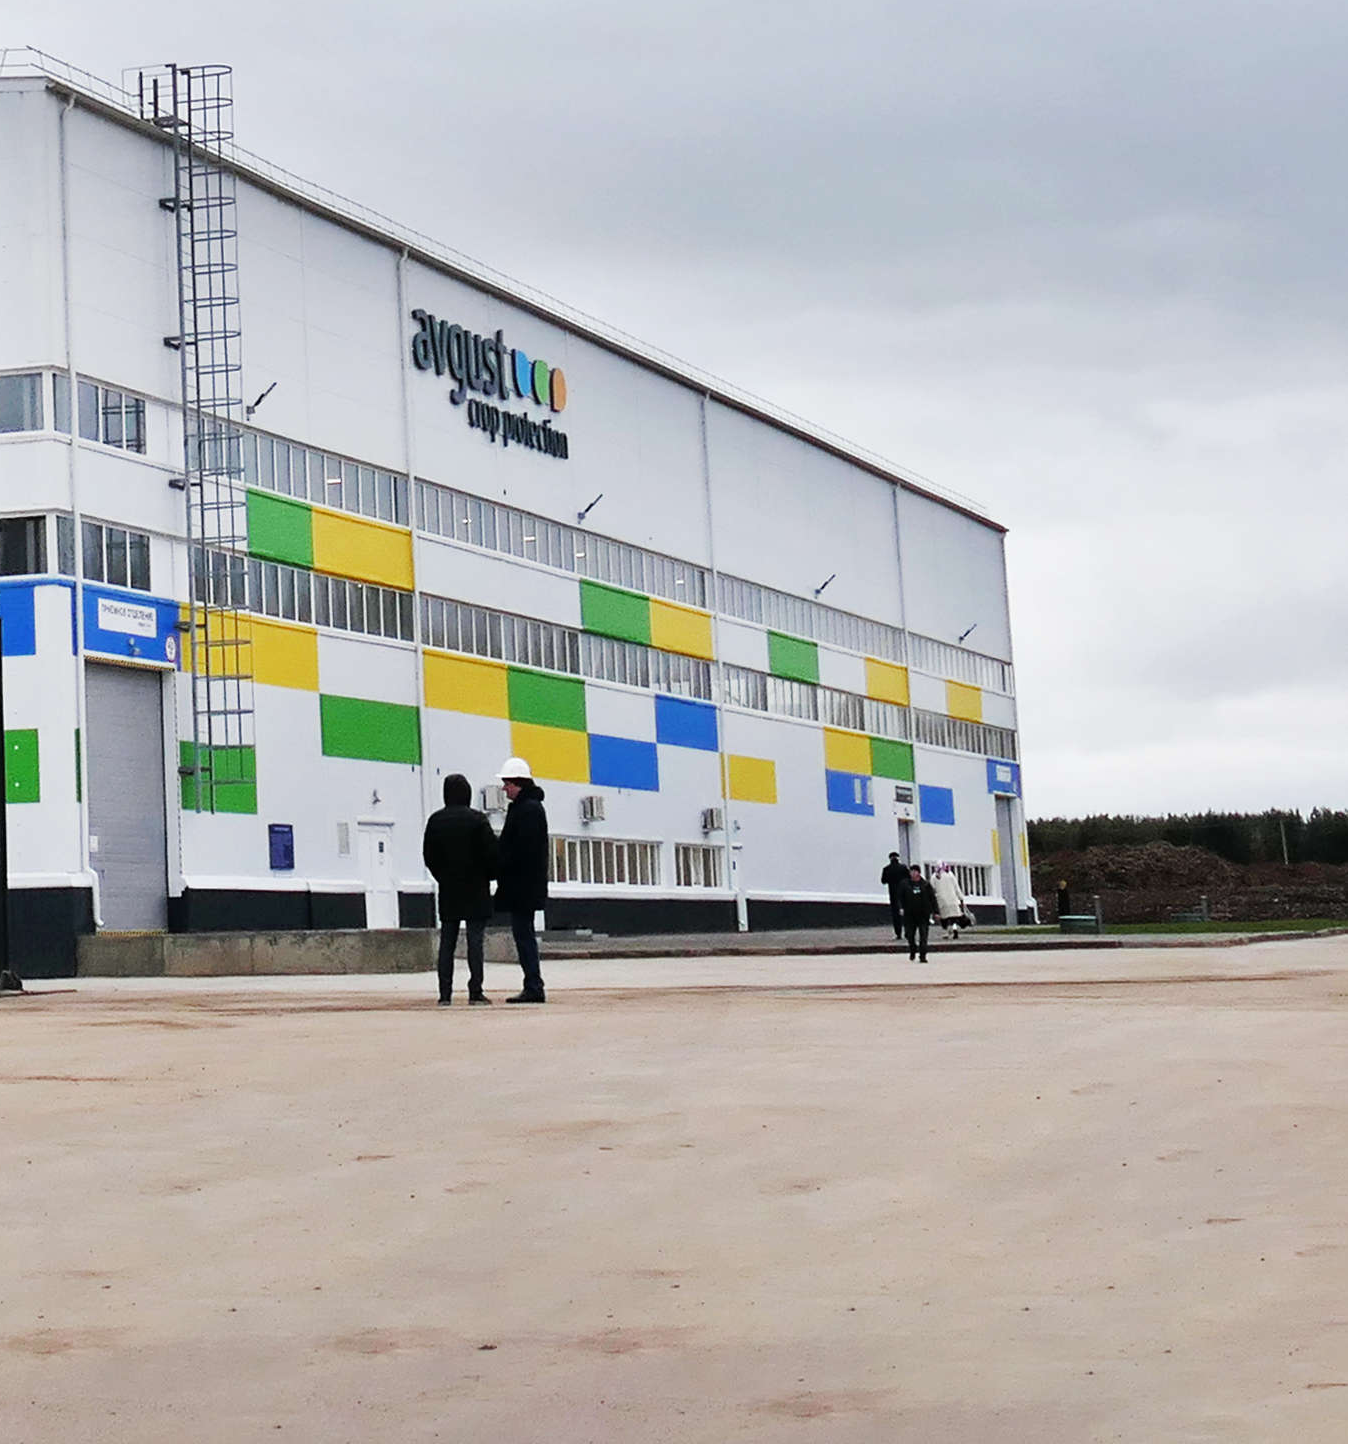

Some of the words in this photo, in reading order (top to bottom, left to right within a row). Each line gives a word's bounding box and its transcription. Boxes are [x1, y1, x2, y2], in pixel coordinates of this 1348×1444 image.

[410, 308, 511, 405] avgust
[467, 398, 501, 443] crop
[502, 411, 569, 460] protection
